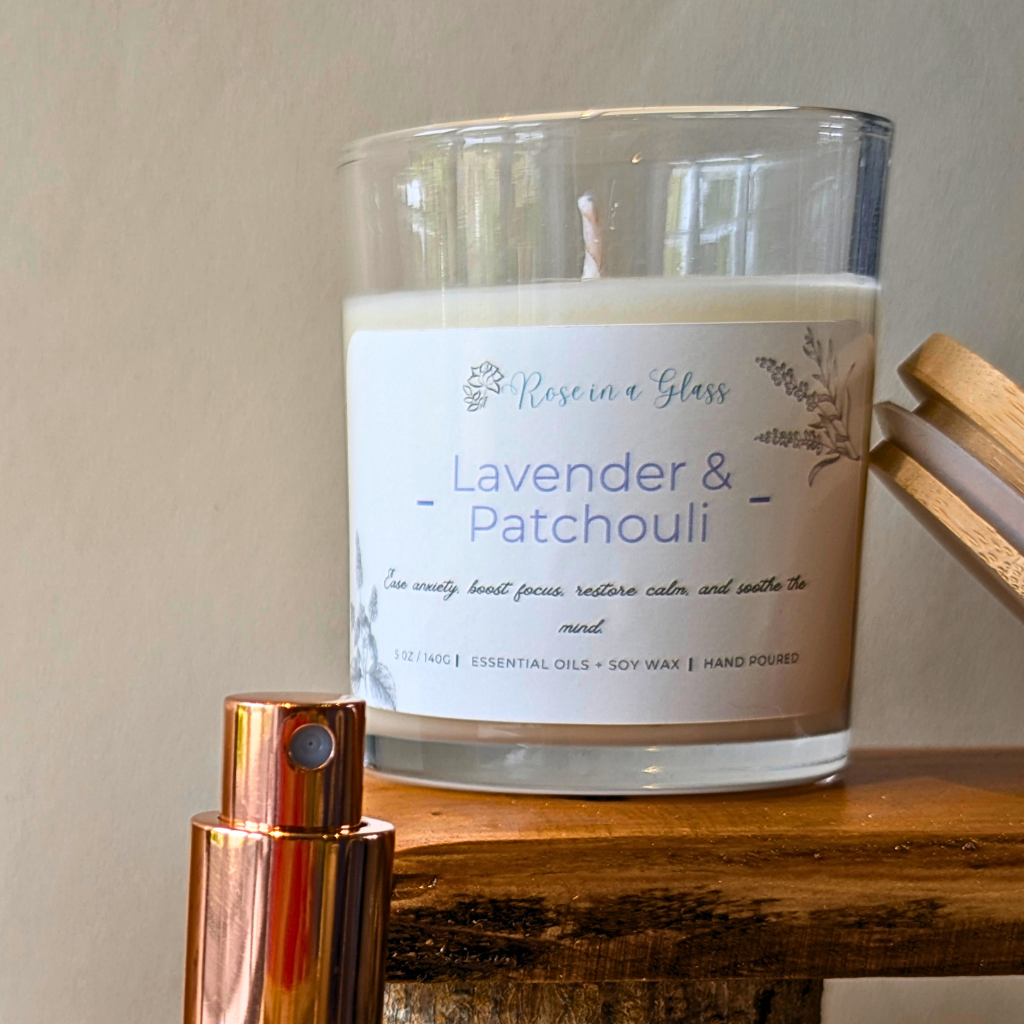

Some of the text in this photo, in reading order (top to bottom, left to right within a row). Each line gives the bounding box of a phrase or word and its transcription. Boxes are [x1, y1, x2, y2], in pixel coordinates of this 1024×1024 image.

[501, 368, 731, 410] Rose in a Glass
[453, 451, 733, 493] Lavender &
[469, 502, 709, 543] Patchouli
[383, 568, 408, 590] Ease
[467, 579, 514, 596] boost
[574, 582, 638, 597] restore
[698, 578, 734, 595] and
[736, 575, 783, 595] soothe
[786, 574, 807, 591] the
[394, 649, 400, 660] 5
[401, 650, 414, 662] OZ
[423, 652, 451, 665] 140G
[471, 656, 549, 670] ESSENTIAL
[554, 659, 590, 671] OILS
[608, 659, 640, 671] SOY
[645, 659, 680, 671] WAX
[704, 656, 745, 669] HAND
[749, 652, 800, 666] POURED
